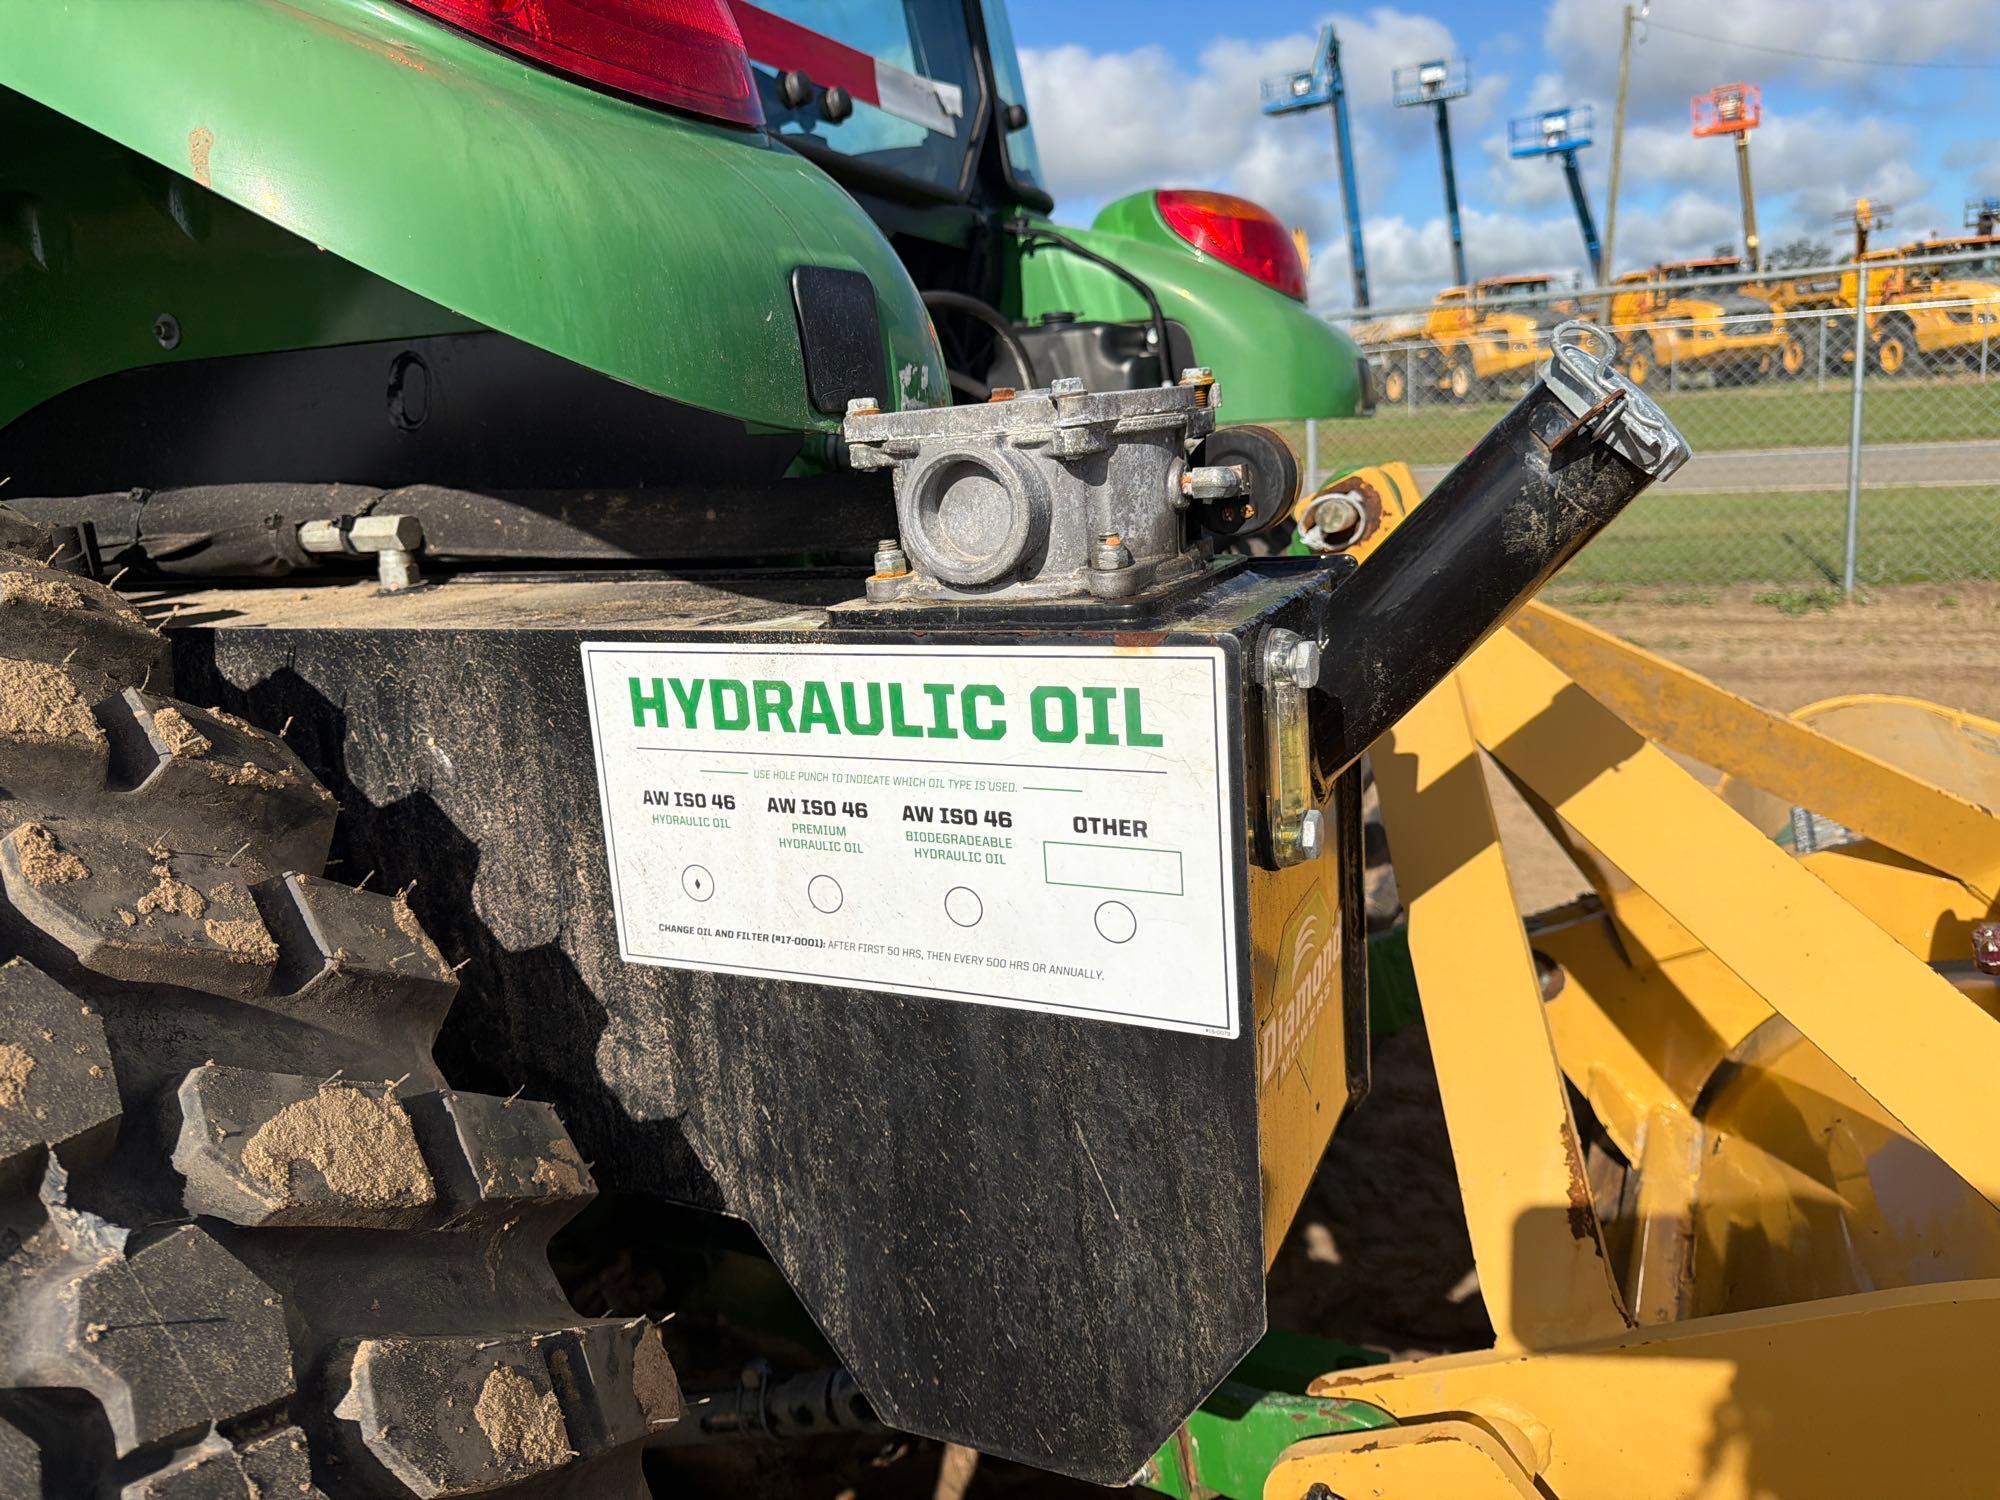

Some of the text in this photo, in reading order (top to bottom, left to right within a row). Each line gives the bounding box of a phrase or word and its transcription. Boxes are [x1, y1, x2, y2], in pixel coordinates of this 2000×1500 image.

[628, 677, 1164, 748] HYDRAULIC OIL
[753, 769, 1018, 793] USE HOLE PUNCH TO INDICATE WHICH OIL TYPE IS USED.
[642, 790, 736, 811] AW ISO 46
[767, 797, 868, 819] AW ISO 46
[652, 813, 732, 829] HYDRAULIC OIL
[902, 805, 1012, 828] AW ISO 46
[1072, 815, 1148, 838] OTHER
[791, 823, 847, 837] PREMIUM
[905, 830, 1013, 849] BIODEGRADEABLE
[778, 837, 864, 854] HYDRAULIC OIL
[914, 847, 1007, 865] HYDRAULIC OIL
[658, 923, 1105, 981] CHANGE OIL AND FILTER (#17-0001): AFTER FIRST 50 HRS, THEN EVERY 500 HRS OR ANNUALLY.
